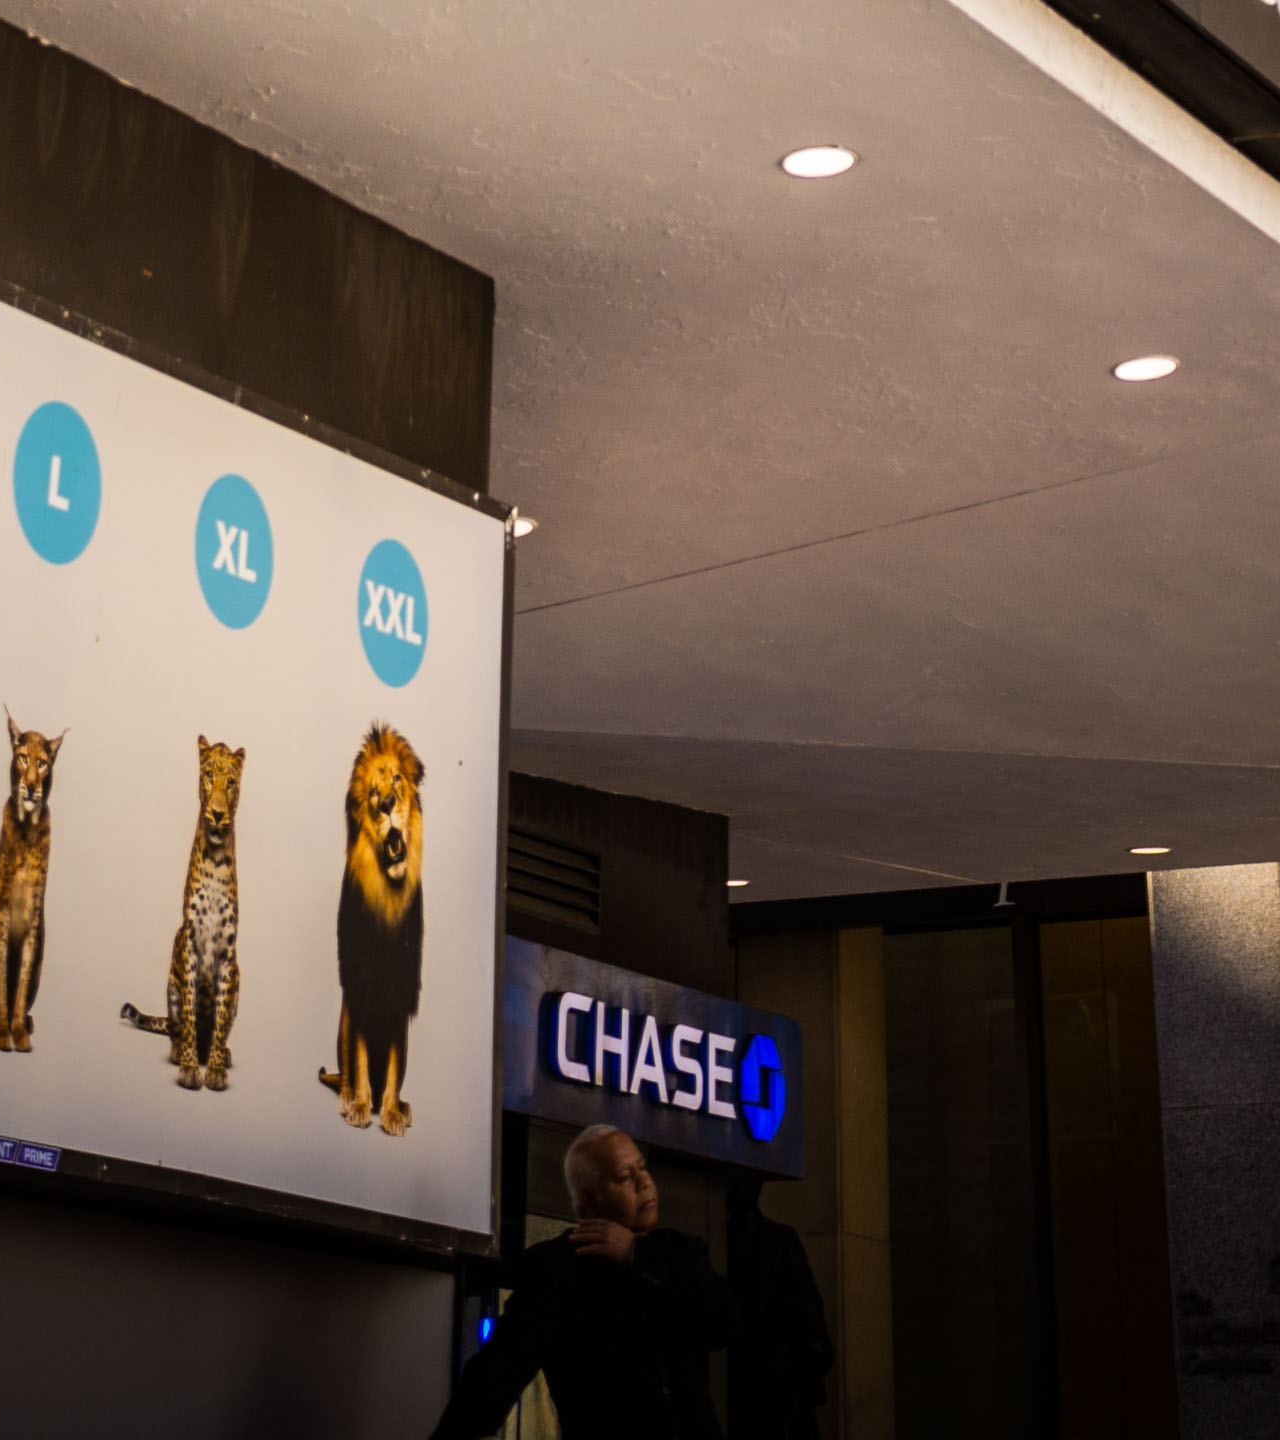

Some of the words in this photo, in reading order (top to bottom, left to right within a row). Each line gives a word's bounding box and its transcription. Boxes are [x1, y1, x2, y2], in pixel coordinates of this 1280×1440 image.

[47, 455, 69, 512] L
[213, 520, 257, 583] XL
[363, 581, 422, 646] XXL
[554, 990, 738, 1120] CHASE
[23, 1147, 55, 1167] PRIME
